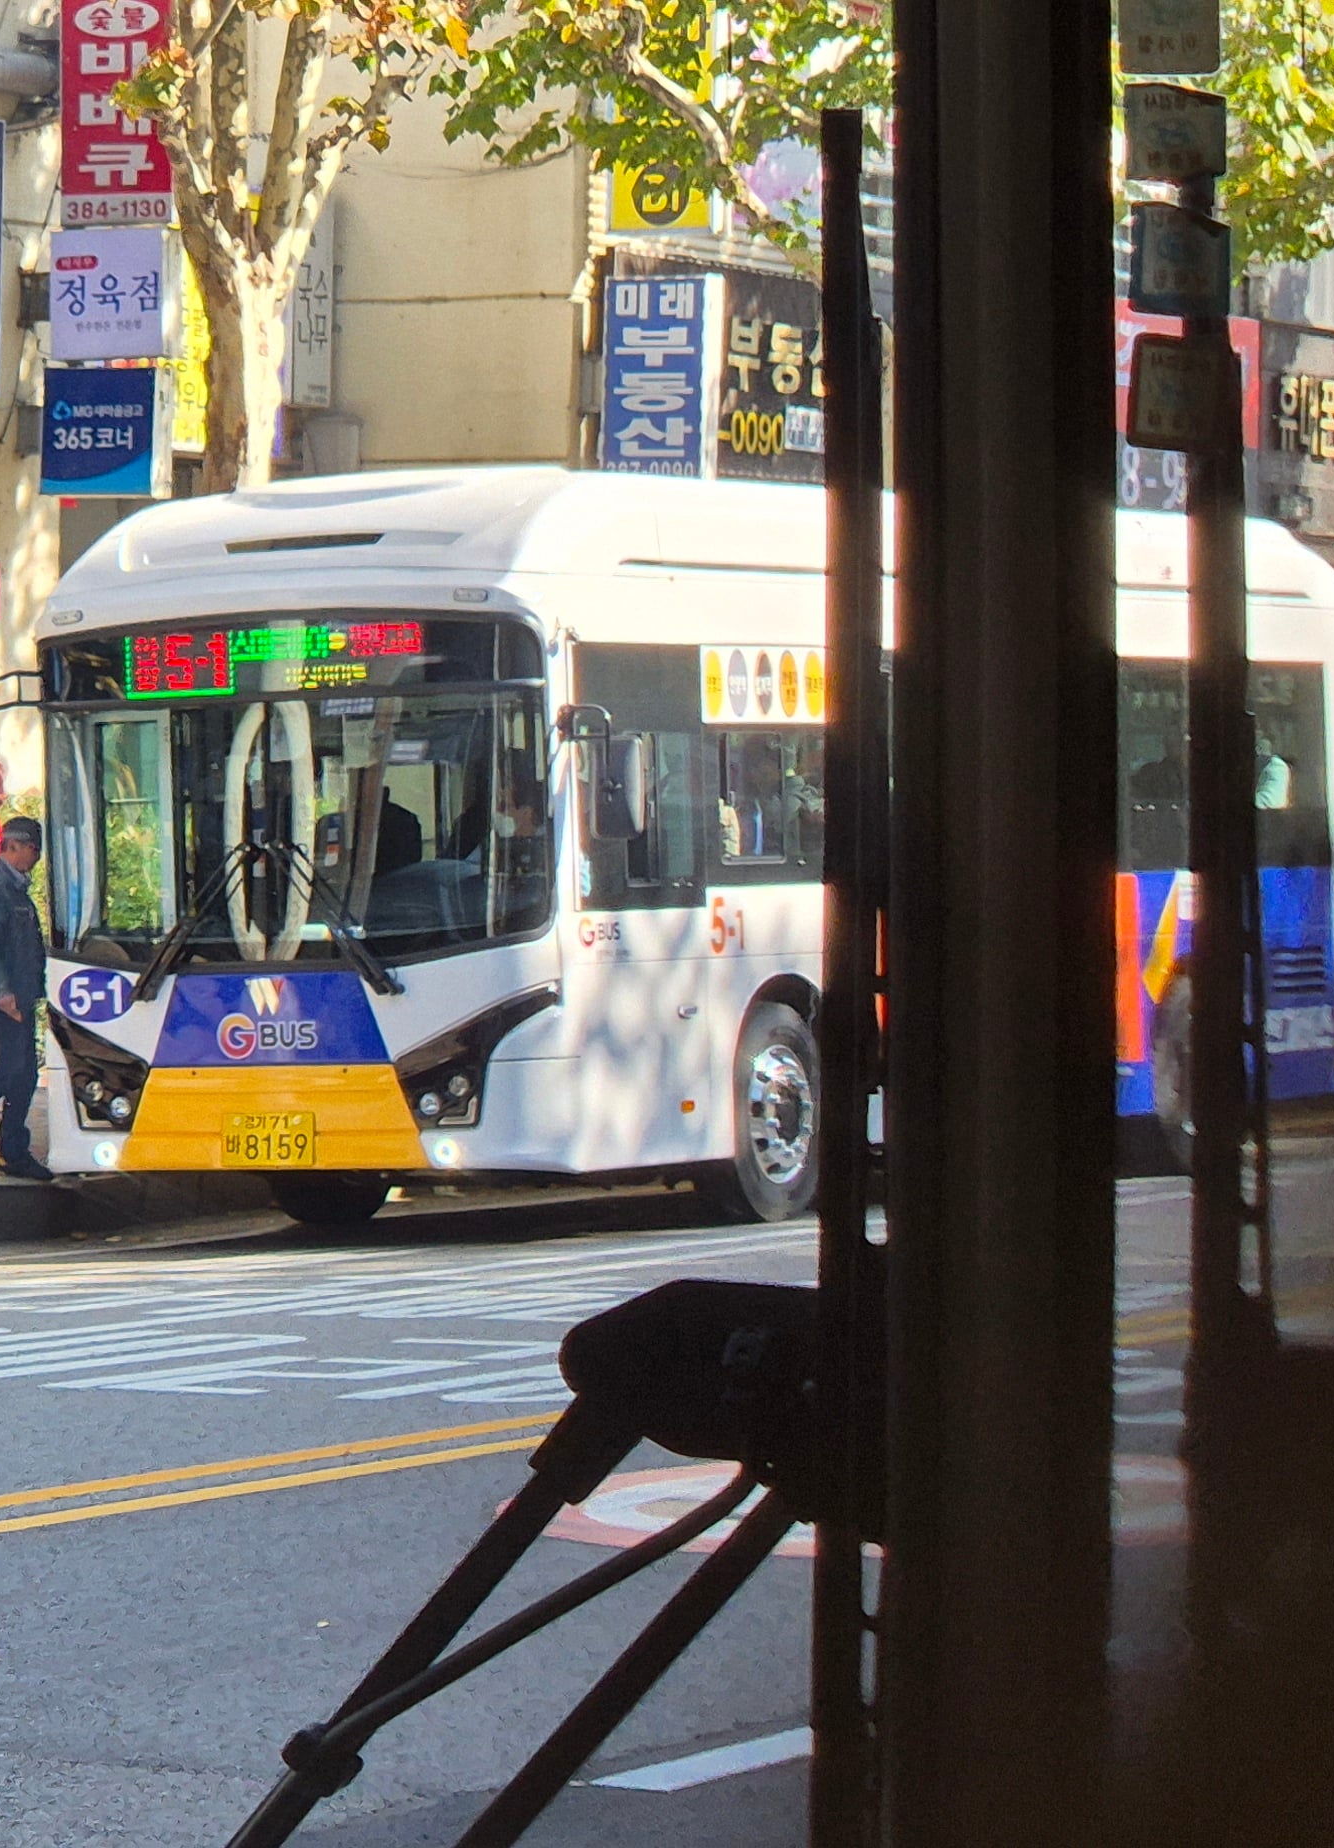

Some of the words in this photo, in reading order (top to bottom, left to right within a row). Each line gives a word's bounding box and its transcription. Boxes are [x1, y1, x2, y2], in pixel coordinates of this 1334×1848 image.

[67, 199, 167, 220] 384-1130
[56, 270, 160, 316] 정육점
[615, 283, 694, 320] 미래
[613, 326, 695, 458] 부동산
[164, 632, 226, 689] 5-1
[711, 896, 745, 954] 5-1
[69, 975, 123, 1016] 5-1
[244, 1114, 267, 1129] 경기
[270, 1115, 289, 1129] 71
[245, 1134, 308, 1160] 8159
